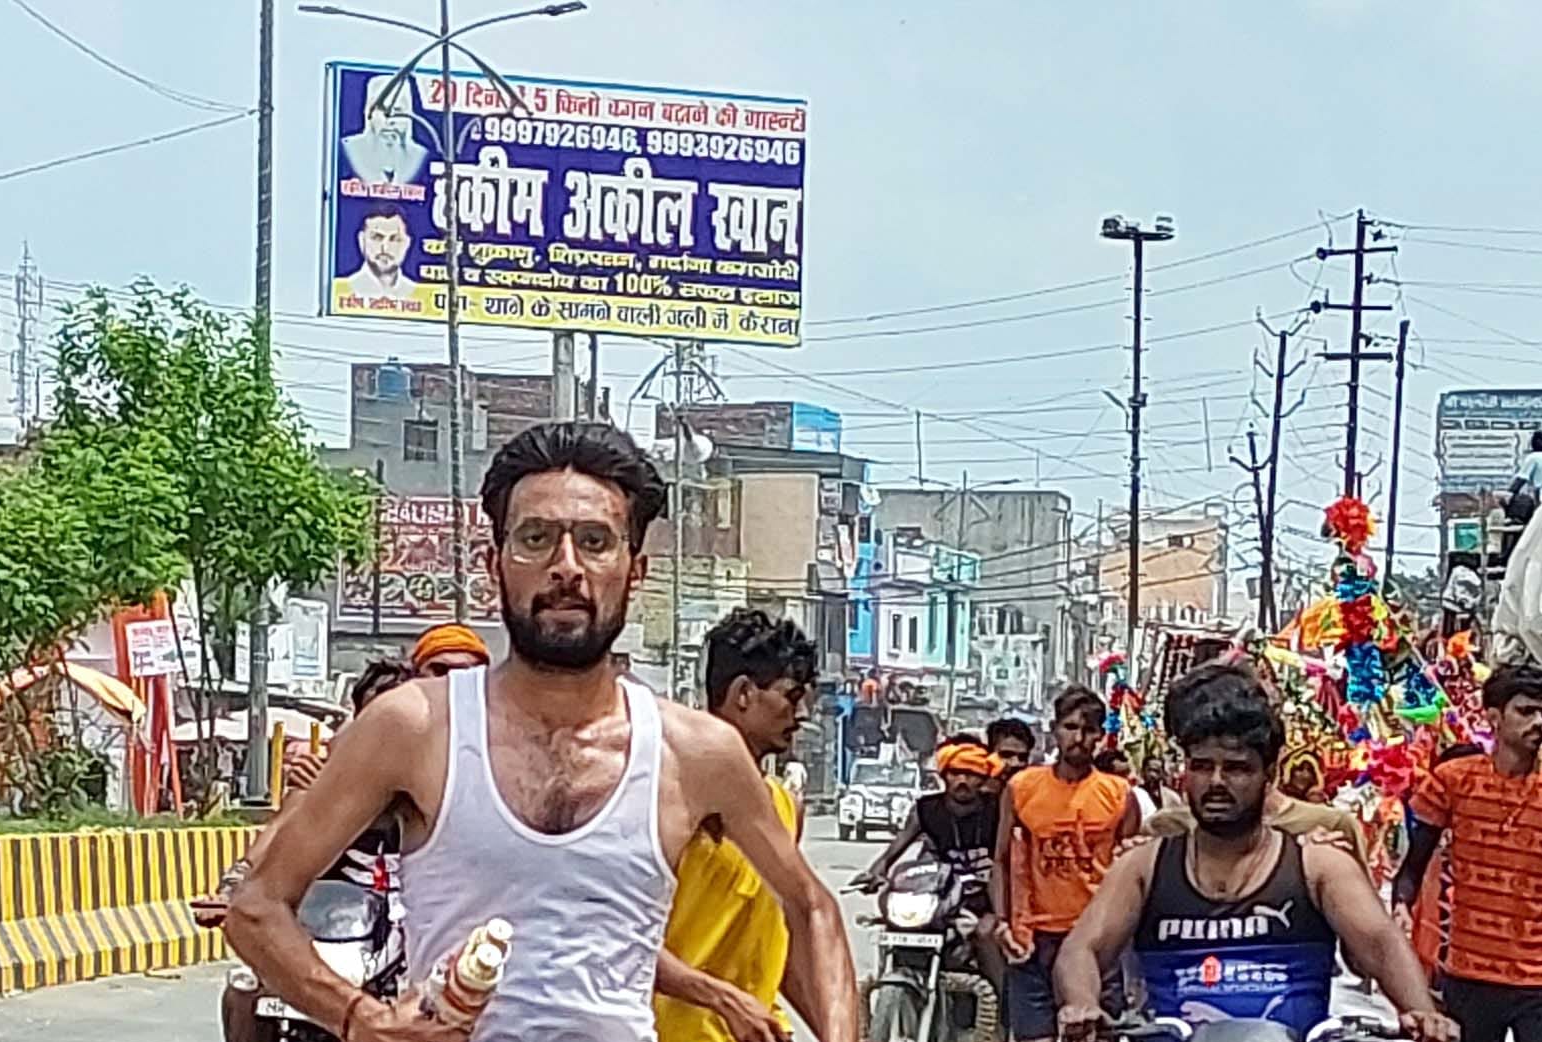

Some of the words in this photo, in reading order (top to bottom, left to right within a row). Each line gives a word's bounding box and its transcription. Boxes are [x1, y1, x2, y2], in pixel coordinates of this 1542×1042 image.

[429, 79, 457, 104] 20
[534, 87, 547, 112] 5
[556, 88, 600, 117] किलो
[715, 102, 738, 128] की
[562, 157, 699, 248] अकील
[709, 181, 802, 256] खान
[614, 271, 673, 296] 100%
[531, 296, 551, 316] के
[617, 303, 660, 327] वाली
[1159, 915, 1268, 941] PUMA
